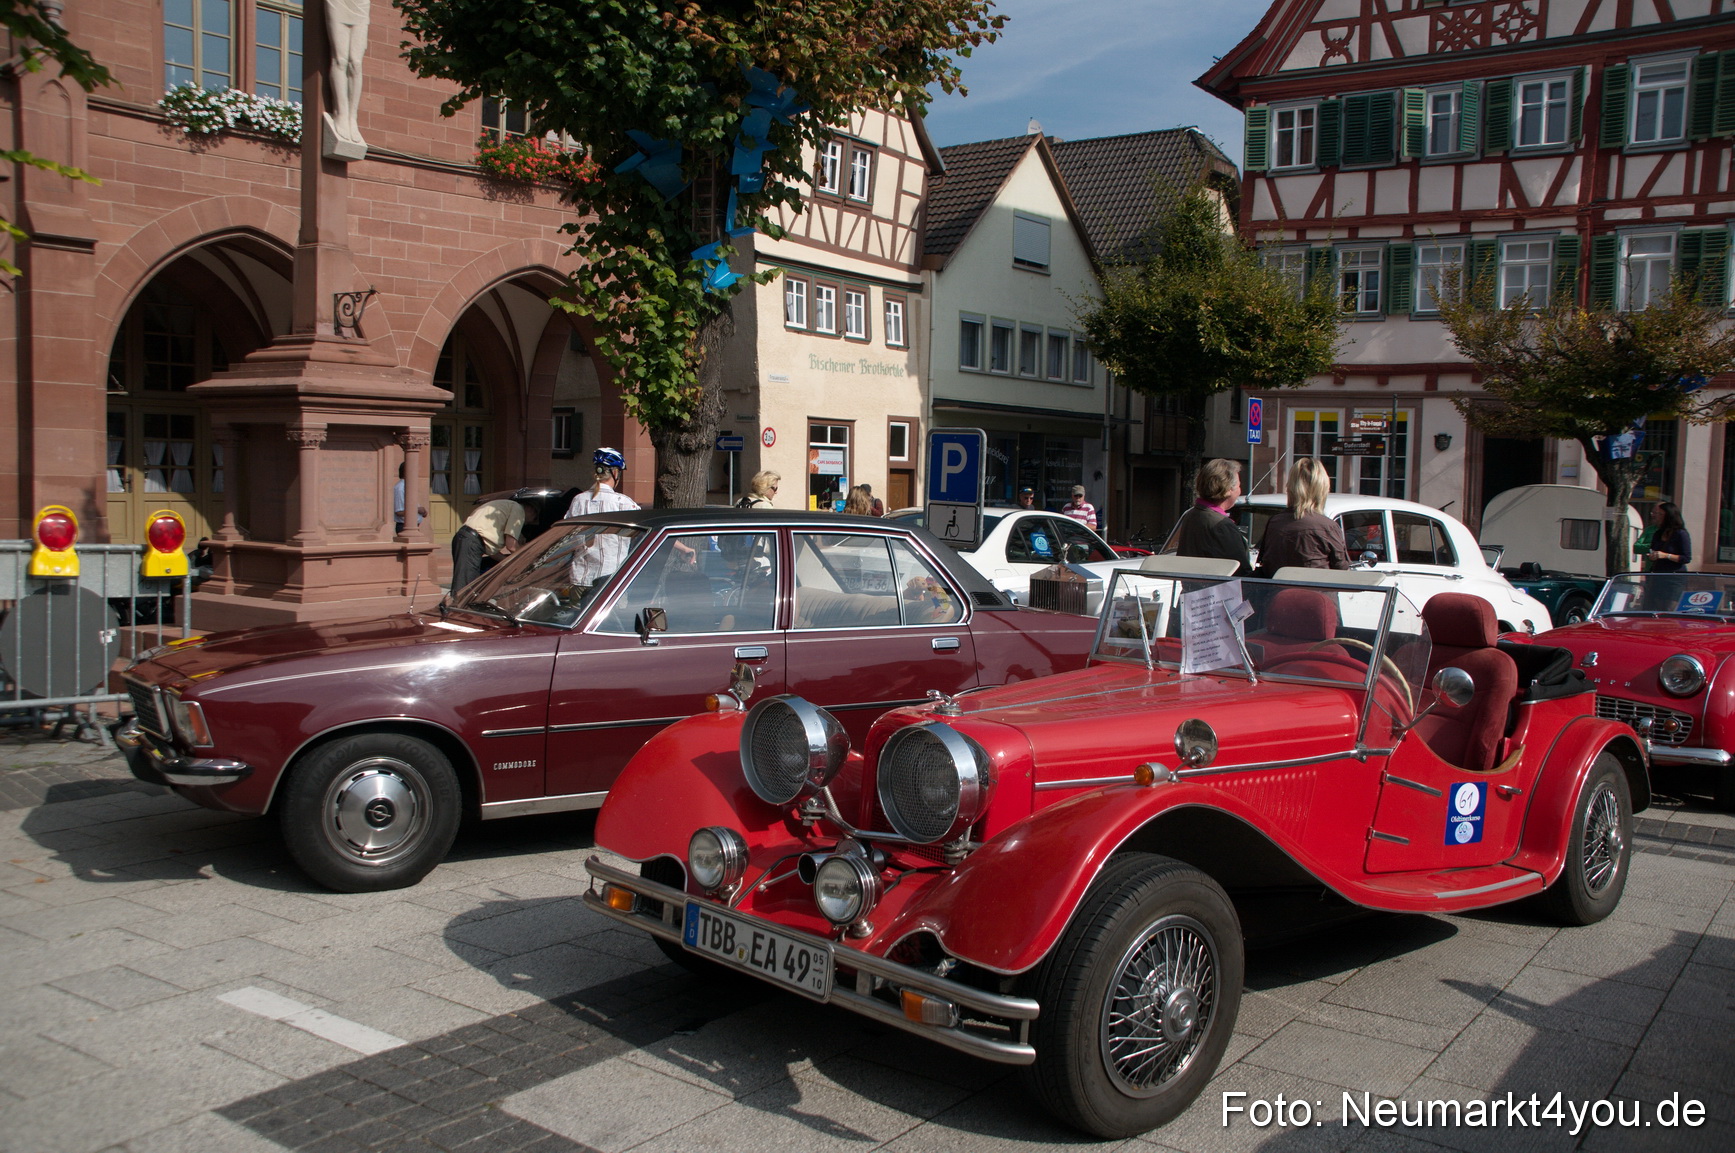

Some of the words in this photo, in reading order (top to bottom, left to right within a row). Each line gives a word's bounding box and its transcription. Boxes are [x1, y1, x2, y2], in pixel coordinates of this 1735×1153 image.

[809, 353, 855, 374] Bischemer
[1250, 430, 1260, 439] TAXI
[940, 442, 968, 493] P
[1690, 593, 1709, 603] 46
[493, 760, 537, 770] COMMODORE
[1460, 790, 1474, 809] 61
[689, 929, 695, 939] D
[700, 912, 736, 955] TBB
[750, 931, 777, 973] EA
[783, 943, 811, 983] 49
[813, 953, 824, 965] 05
[812, 977, 823, 990] 10
